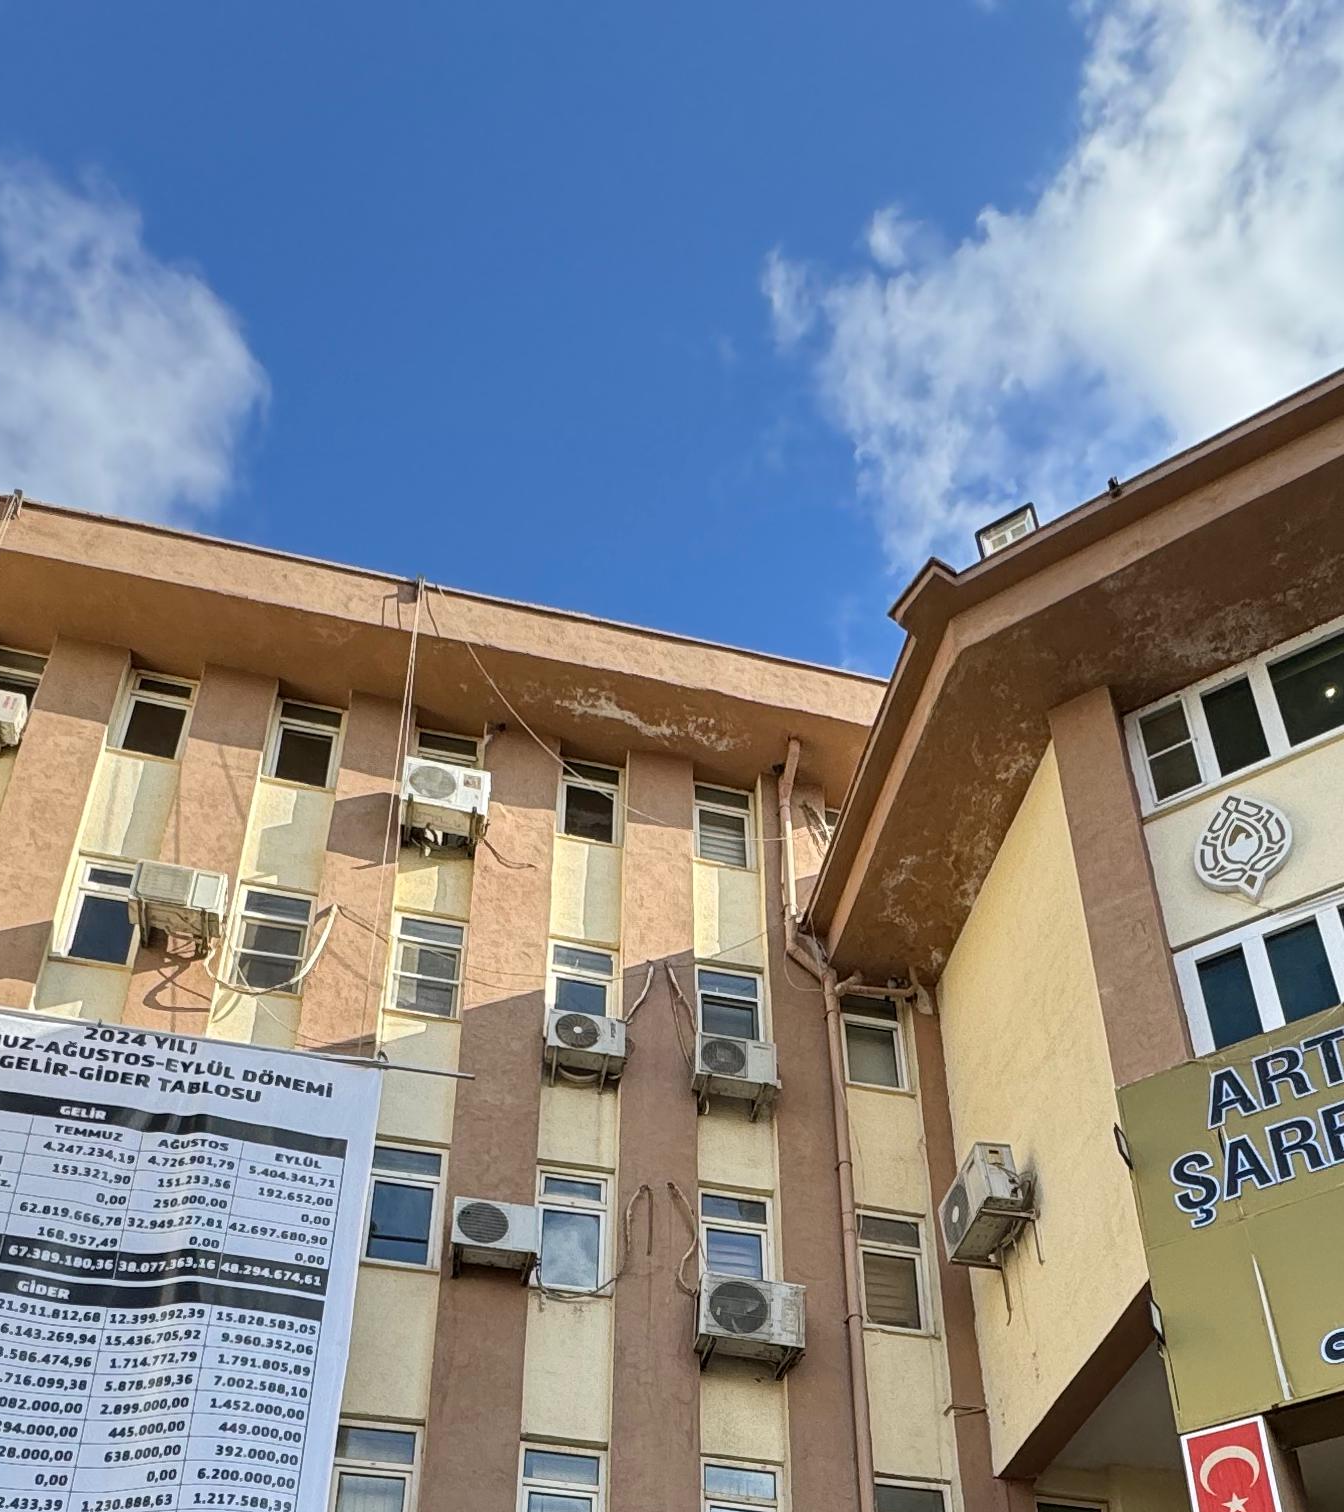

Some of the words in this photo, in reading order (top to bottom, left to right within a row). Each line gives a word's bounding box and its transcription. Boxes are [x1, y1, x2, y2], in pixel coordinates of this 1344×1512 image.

[84, 1027, 146, 1046] 2024
[156, 1036, 197, 1054] YILI
[0, 1054, 150, 1088] GELİR-GİDER
[158, 1077, 261, 1102] TABLOSU
[243, 1069, 333, 1097] DÖNEMİ
[60, 1106, 106, 1120] GELİR
[54, 1124, 123, 1141] TEMMUZ
[158, 1138, 229, 1151] AĞUSTOS
[275, 1153, 322, 1169] EYLÜL
[43, 1141, 135, 1165] 4.247.234,19
[148, 1155, 235, 1171] 4.726.901,79
[249, 1166, 335, 1188] 5.404.341,71
[52, 1163, 131, 1185] 153.321,90
[158, 1175, 231, 1189] 151.233,56
[258, 1187, 333, 1207] 192.652,00
[96, 1193, 127, 1205] 0,00
[154, 1196, 227, 1209] 250.000,00
[301, 1213, 331, 1226] 0,00
[19, 1202, 122, 1226] 62.819.666,78
[128, 1215, 223, 1230] 32.949.227,81
[229, 1223, 328, 1246] 42.697.680,90
[37, 1226, 118, 1248] 168.957,49
[189, 1236, 220, 1249] 0,00
[295, 1252, 324, 1266] 0,00
[9, 1244, 113, 1271] 67.389.180,36
[118, 1257, 215, 1272] 38.077.363,16
[221, 1262, 321, 1286] 48.294.674,61
[18, 1280, 70, 1299] GİDER
[109, 1308, 205, 1325] 12.399.992,39
[216, 1311, 316, 1336] 15.828.583,05
[105, 1329, 201, 1346] 15.436.705,92
[221, 1332, 314, 1356] 9.960.352,06
[109, 1352, 197, 1369] 1.714.772,79
[218, 1354, 311, 1376] 1.791.805,89
[104, 1374, 193, 1392] 5.878.989,36
[213, 1375, 307, 1399] 7.002.588,10
[100, 1397, 189, 1415] 2.899.000,00
[210, 1399, 304, 1420] 1.452.000,00
[109, 1420, 185, 1439] 445.000,00
[218, 1422, 301, 1443] 449.000,00
[104, 1444, 181, 1463] 638.000,00
[215, 1445, 298, 1465] 392.000,00
[35, 1473, 68, 1486] 0,00
[147, 1469, 177, 1483] 0,00
[197, 1468, 296, 1490] 6.200.000,00
[81, 1494, 172, 1512] 1.230.888,63
[193, 1492, 292, 1512] 1.217.588,39
